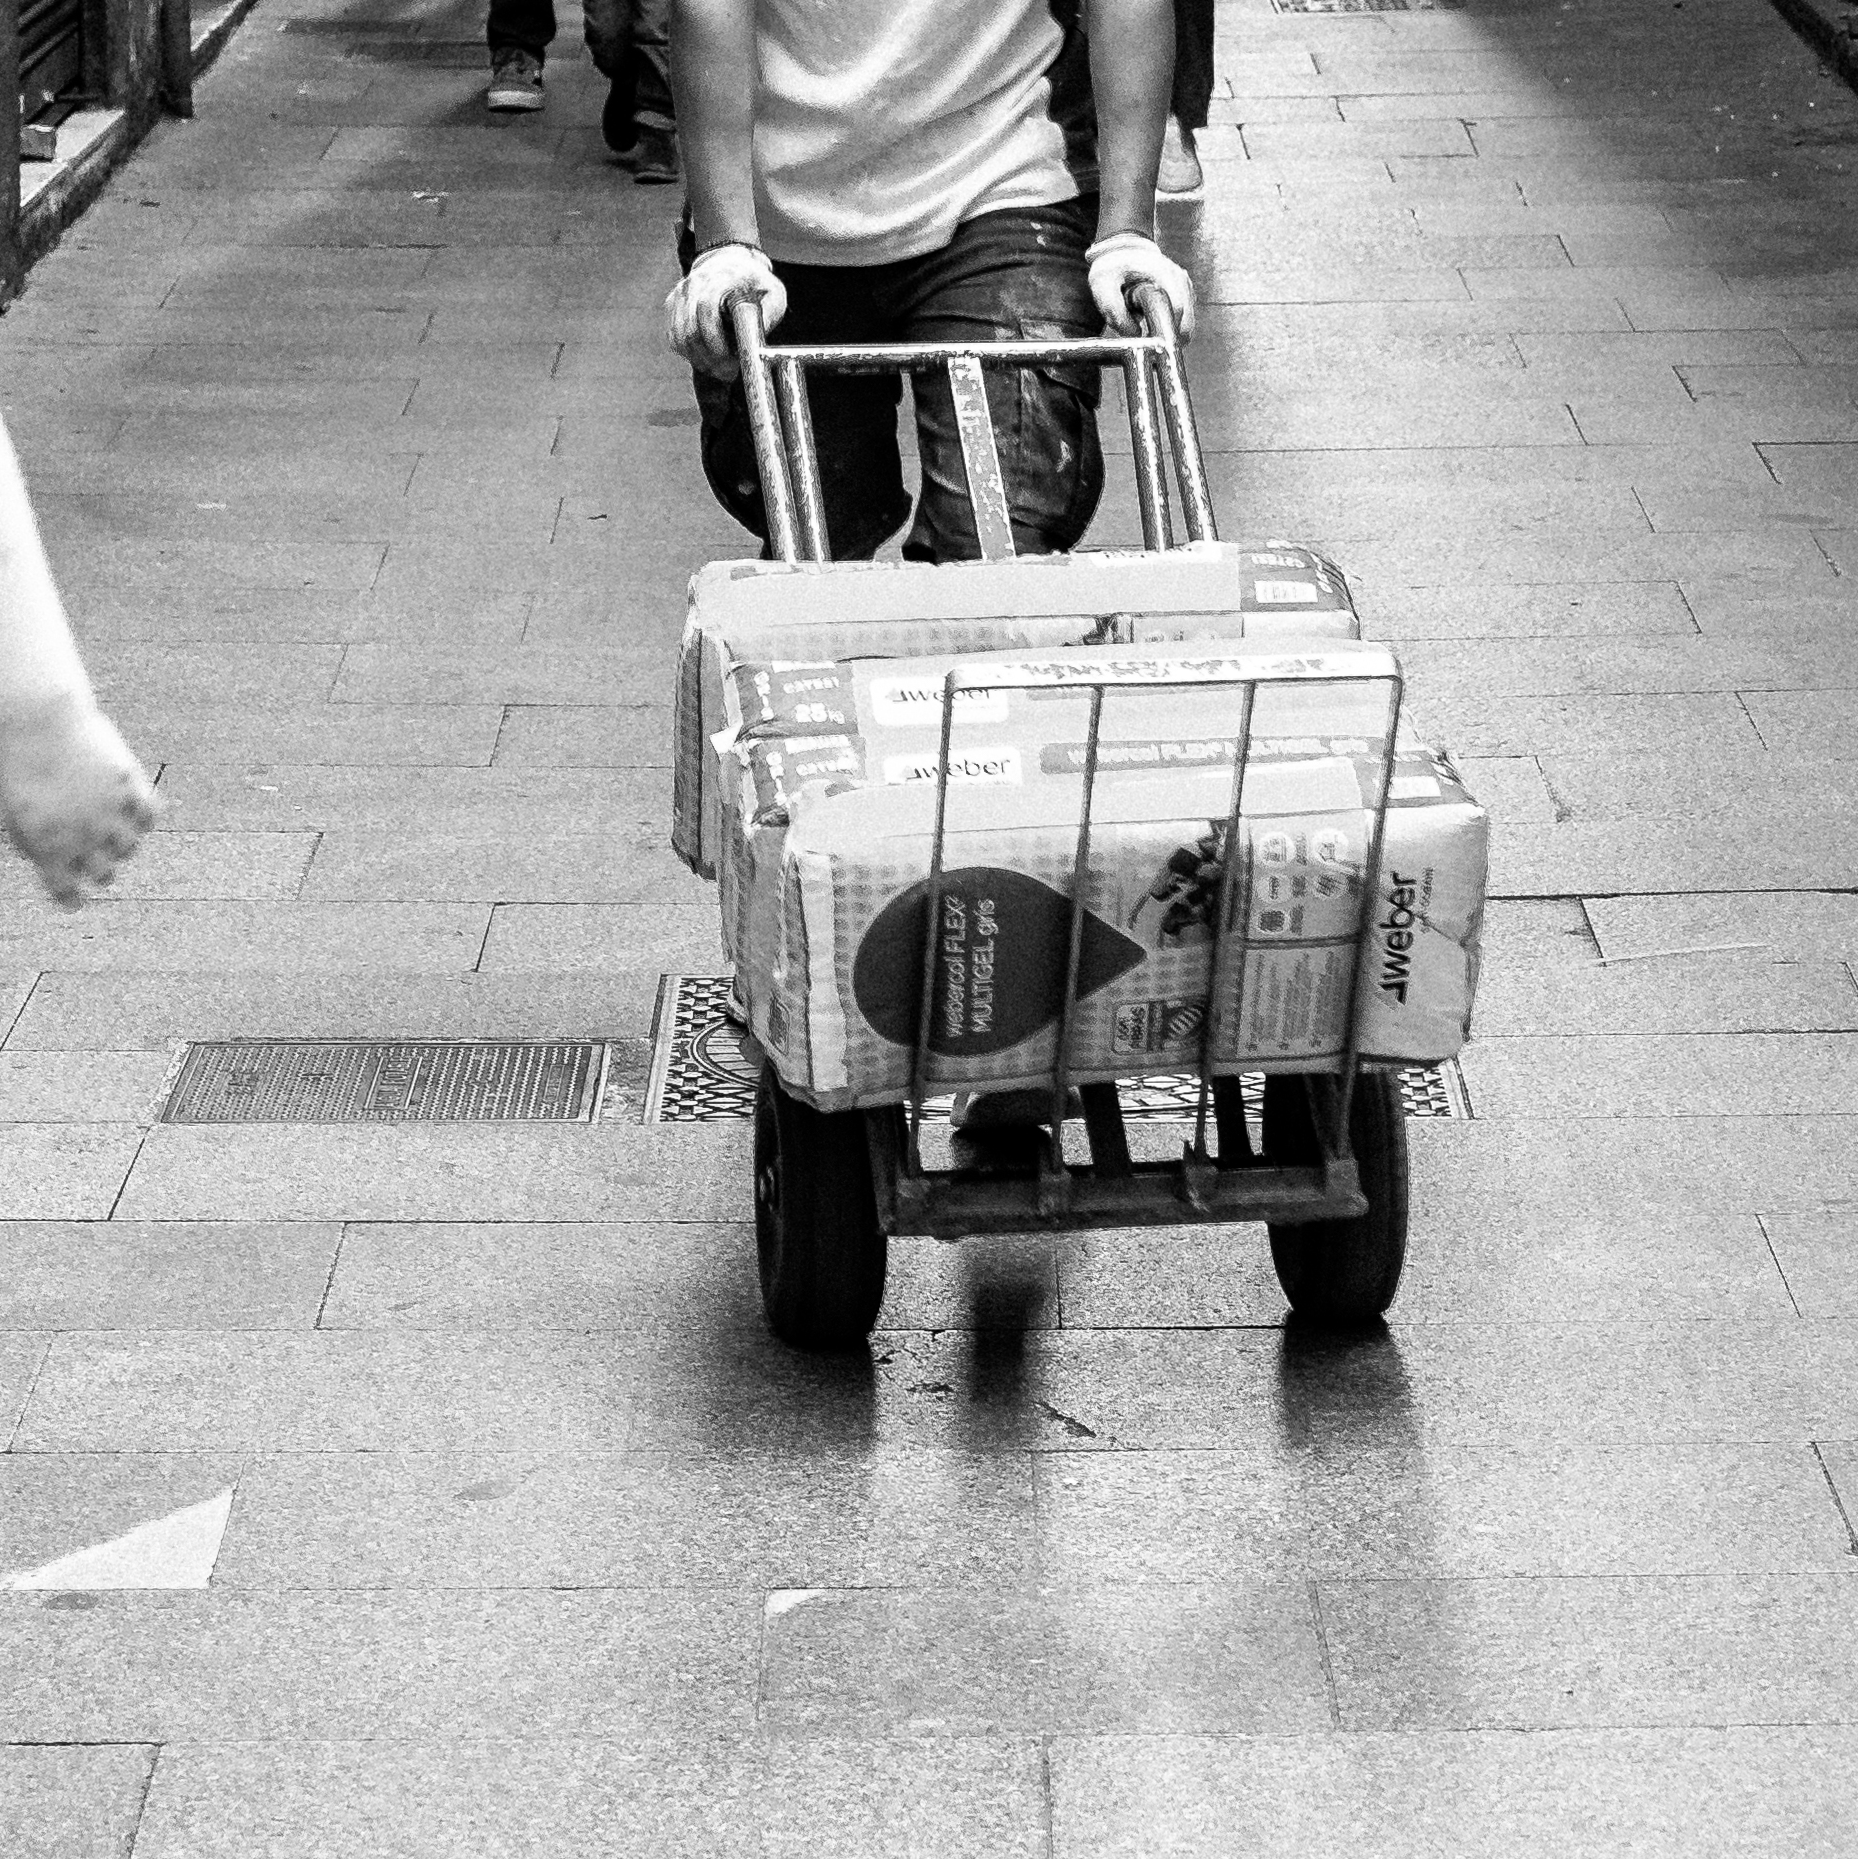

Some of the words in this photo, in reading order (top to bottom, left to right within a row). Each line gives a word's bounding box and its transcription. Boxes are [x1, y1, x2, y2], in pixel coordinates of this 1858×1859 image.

[1378, 870, 1417, 981] weber
[943, 956, 966, 1039] webercol
[970, 938, 995, 1034] MULTIGEL
